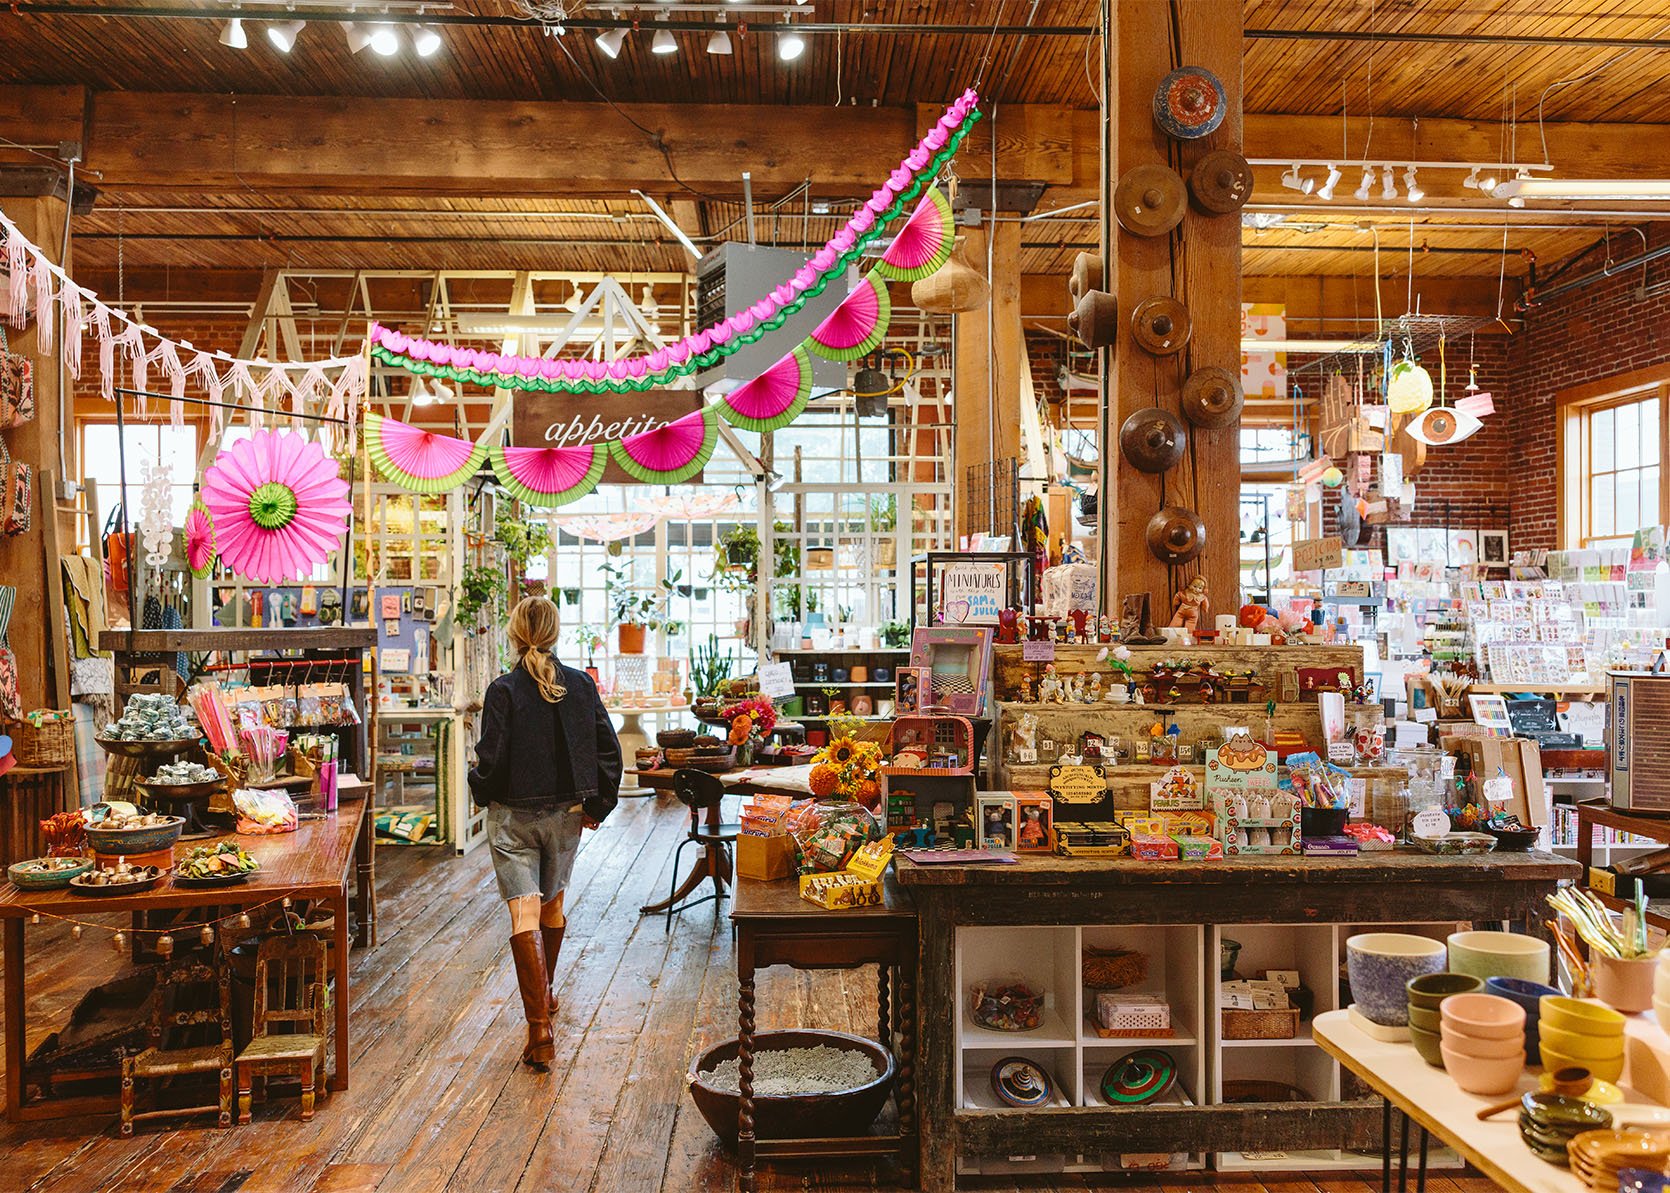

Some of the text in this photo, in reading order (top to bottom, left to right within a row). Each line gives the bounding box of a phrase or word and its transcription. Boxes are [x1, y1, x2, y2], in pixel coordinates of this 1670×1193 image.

[967, 595, 988, 606] SAM
[973, 607, 999, 617] JULIA
[1214, 774, 1243, 783] Pusheen
[1108, 1029, 1175, 1038] PIMIENTO
